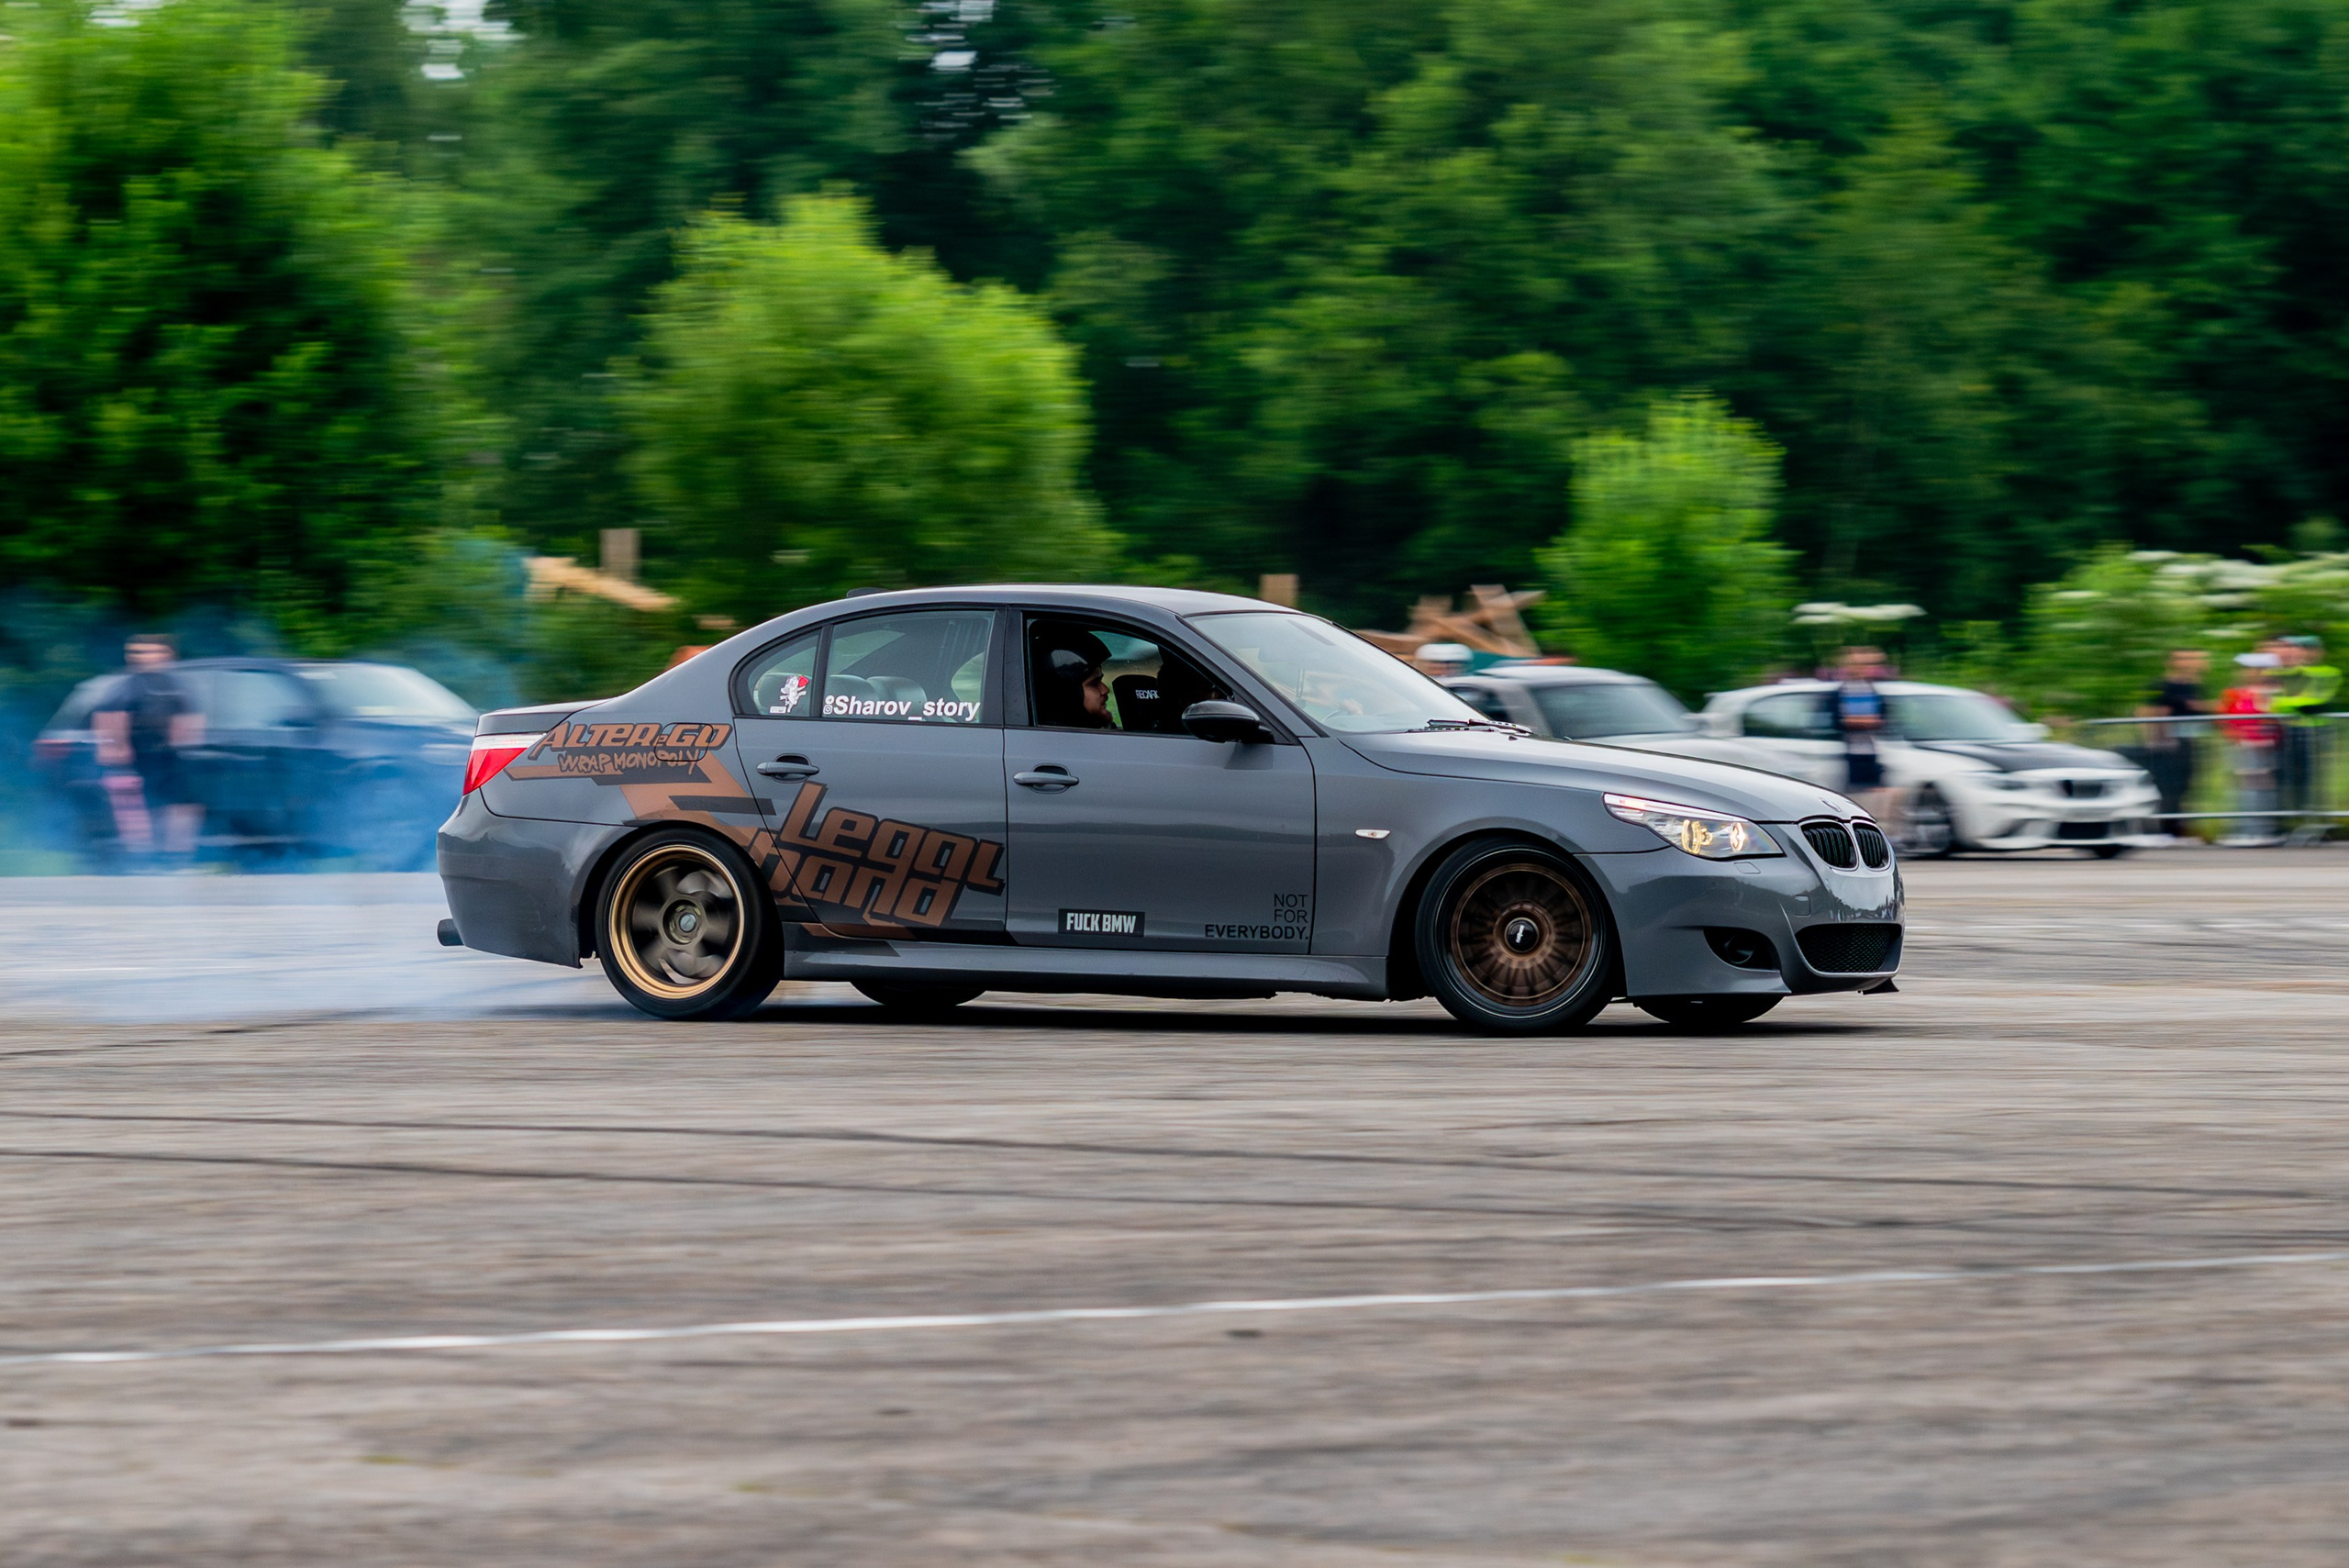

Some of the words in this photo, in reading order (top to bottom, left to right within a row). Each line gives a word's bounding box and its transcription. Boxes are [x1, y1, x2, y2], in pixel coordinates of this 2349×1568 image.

[1135, 689, 1160, 699] RECAR
[834, 695, 980, 722] Sharov_story
[559, 753, 613, 773] WRAP
[613, 749, 699, 775] MONOPOLY
[780, 781, 1005, 892] Legal
[1274, 894, 1308, 907] NOT
[1066, 912, 1100, 931] FUCK
[1101, 914, 1137, 934] BMW
[1274, 909, 1308, 923] FOR
[1205, 923, 1309, 940] EVERYBODY.
